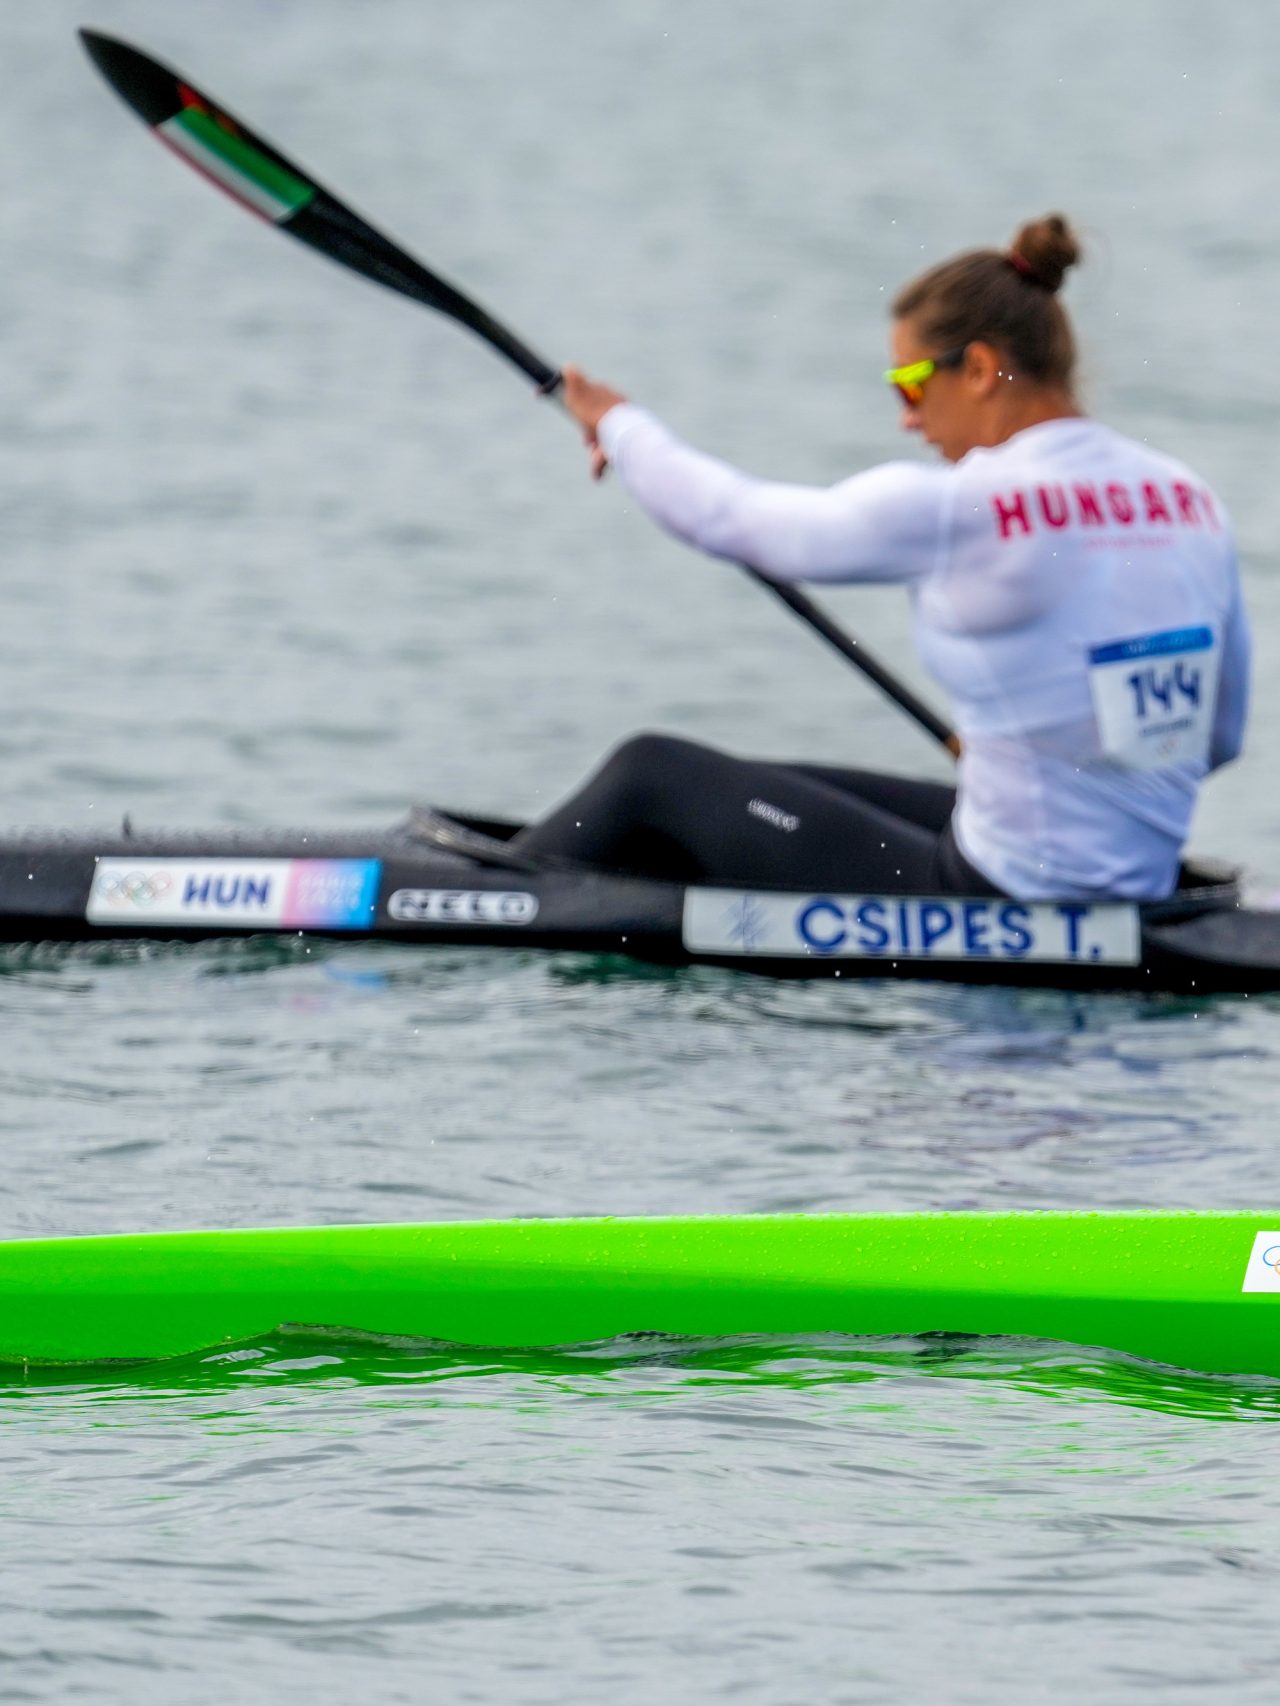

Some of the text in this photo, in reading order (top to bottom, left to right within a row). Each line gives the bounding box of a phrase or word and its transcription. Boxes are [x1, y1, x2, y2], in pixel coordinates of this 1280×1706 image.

[1126, 662, 1200, 718] 144
[183, 874, 271, 908] HUN
[796, 895, 1103, 961] CSIPES T.
